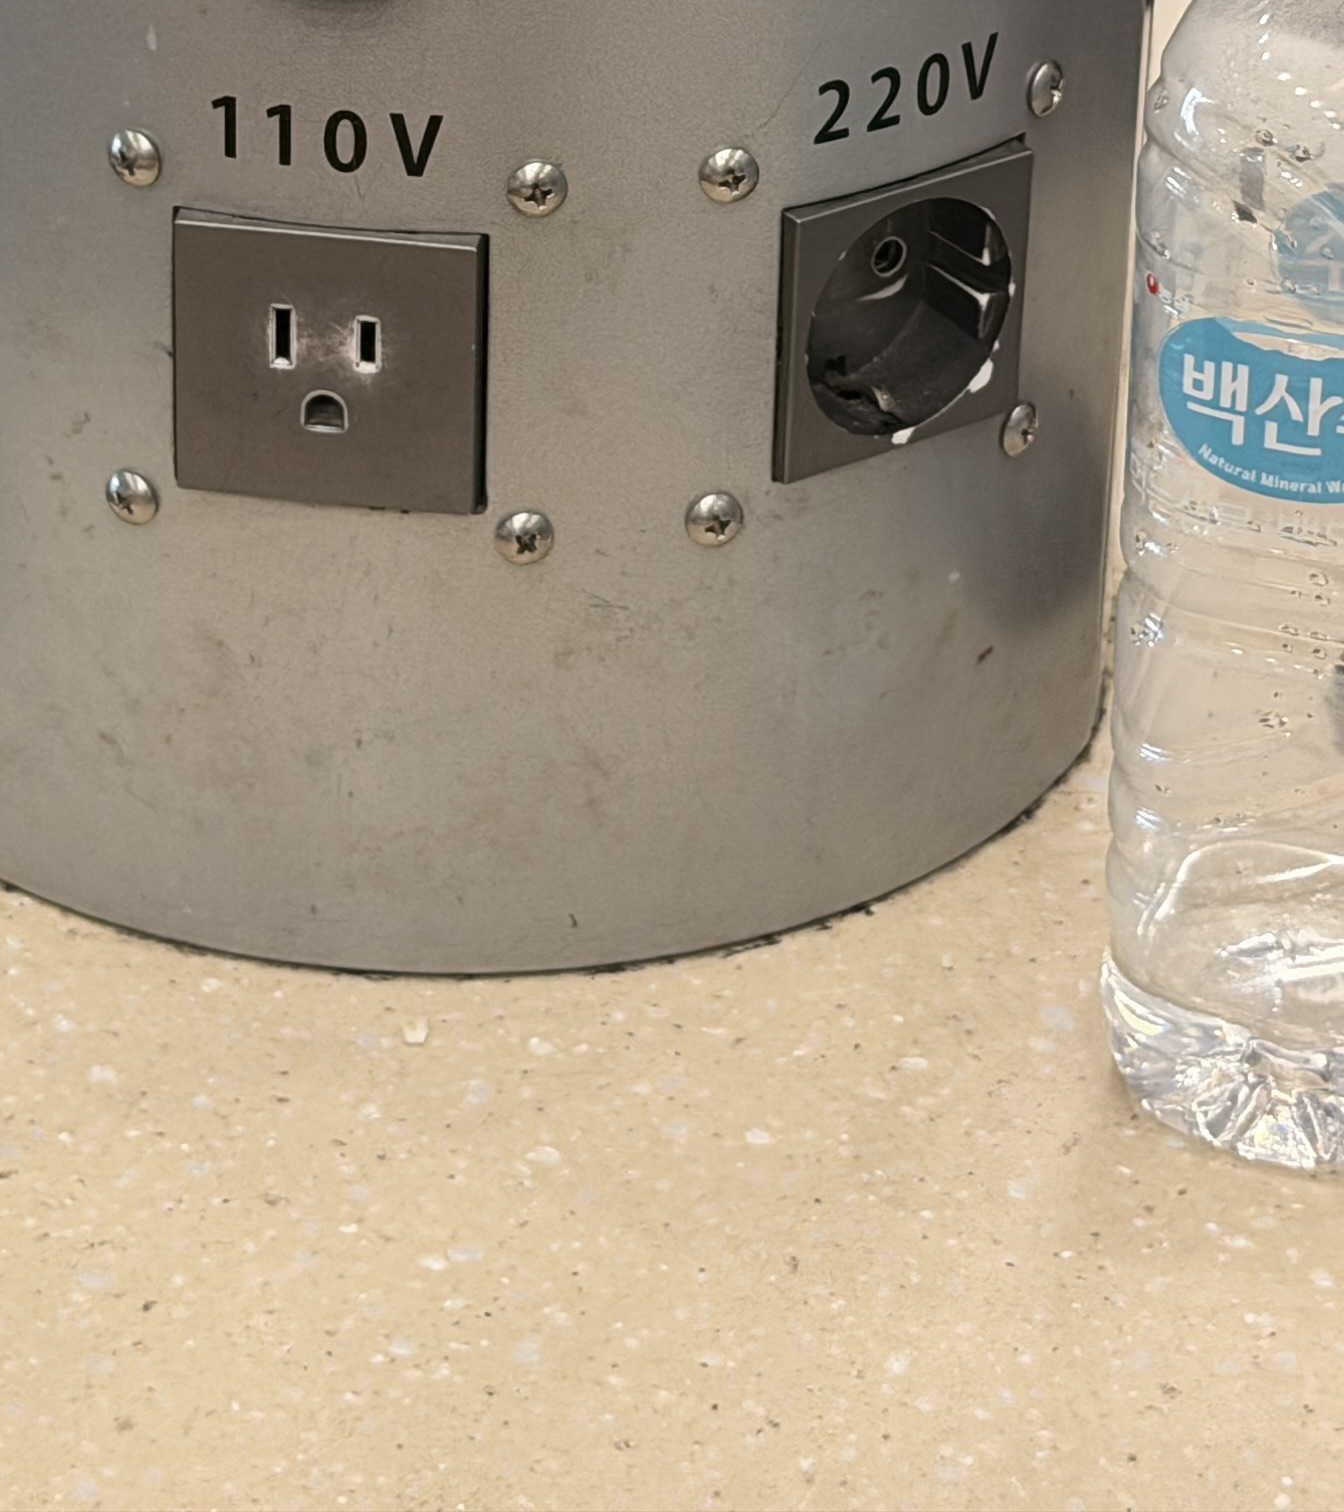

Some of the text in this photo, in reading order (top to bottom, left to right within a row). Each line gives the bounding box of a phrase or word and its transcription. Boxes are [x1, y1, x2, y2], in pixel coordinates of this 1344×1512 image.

[812, 30, 1000, 146] 220V
[210, 94, 445, 179] 110V
[1198, 443, 1257, 482] Natural
[1259, 471, 1323, 494] Mineral
